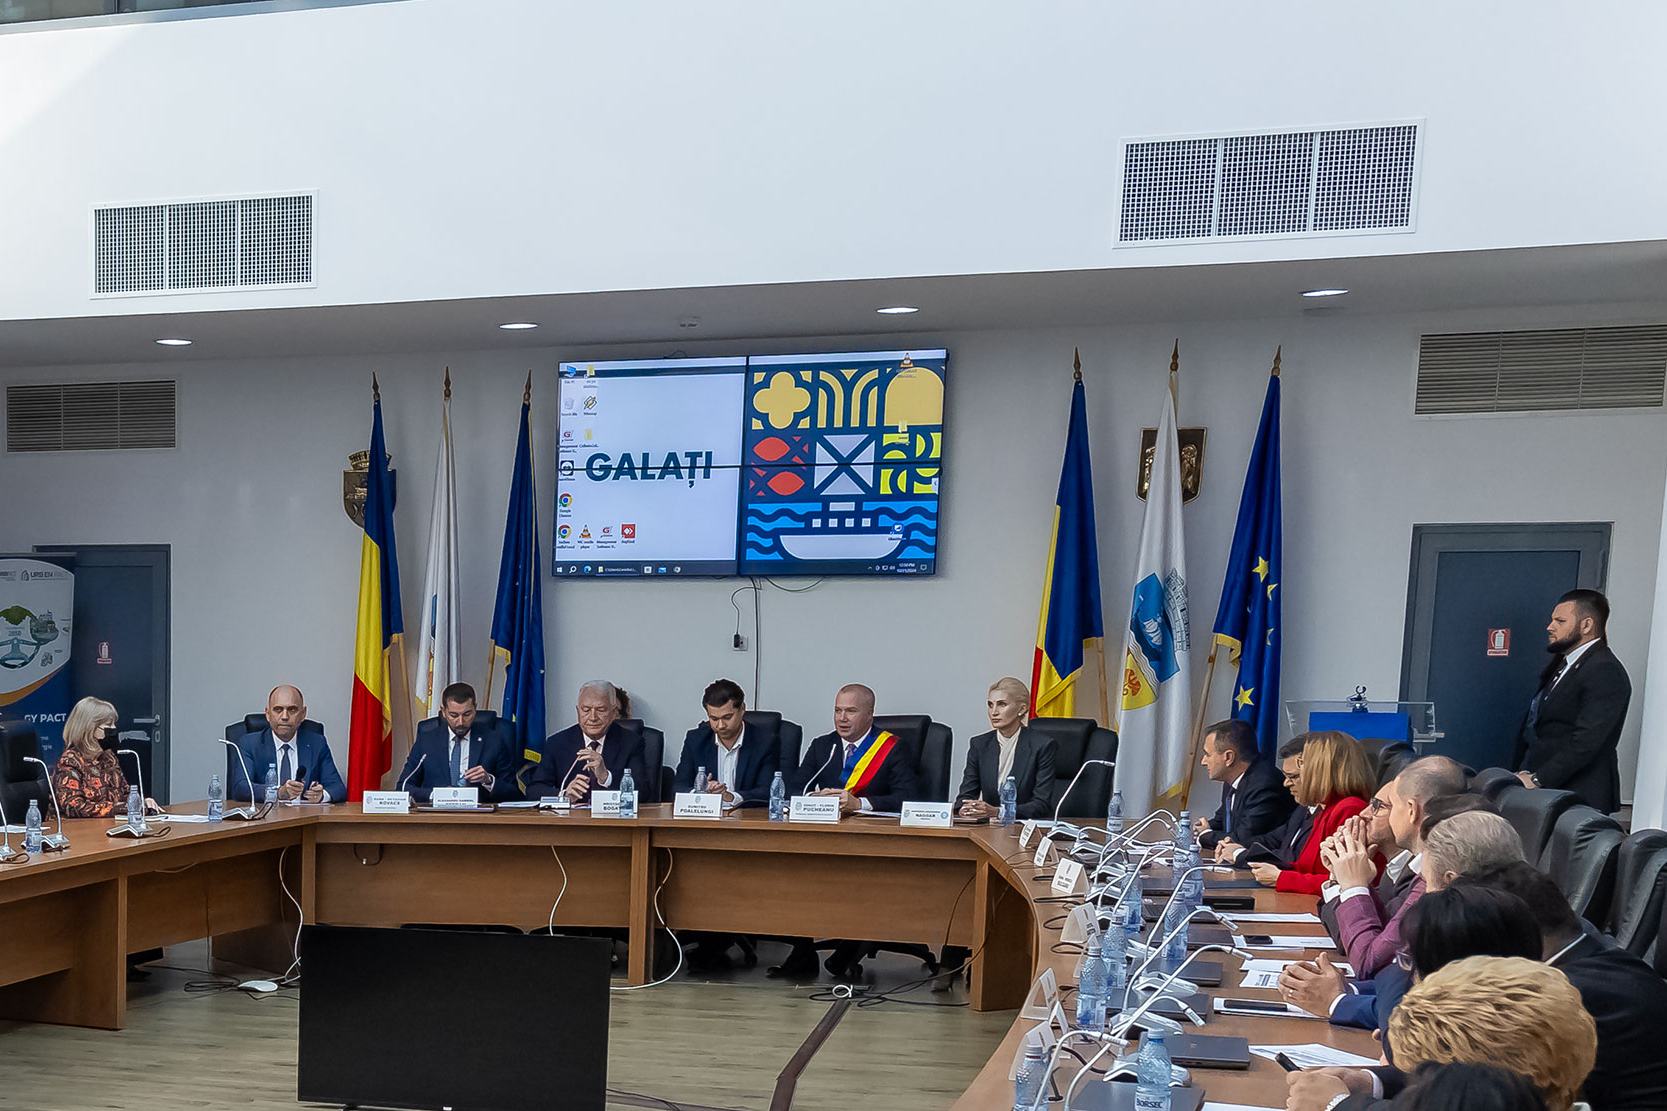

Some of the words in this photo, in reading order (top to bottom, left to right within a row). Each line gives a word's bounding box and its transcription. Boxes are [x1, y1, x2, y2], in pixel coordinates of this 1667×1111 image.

[586, 451, 713, 489] GALAȚI
[40, 713, 67, 723] PACT
[1136, 1098, 1163, 1109] BORSEC
